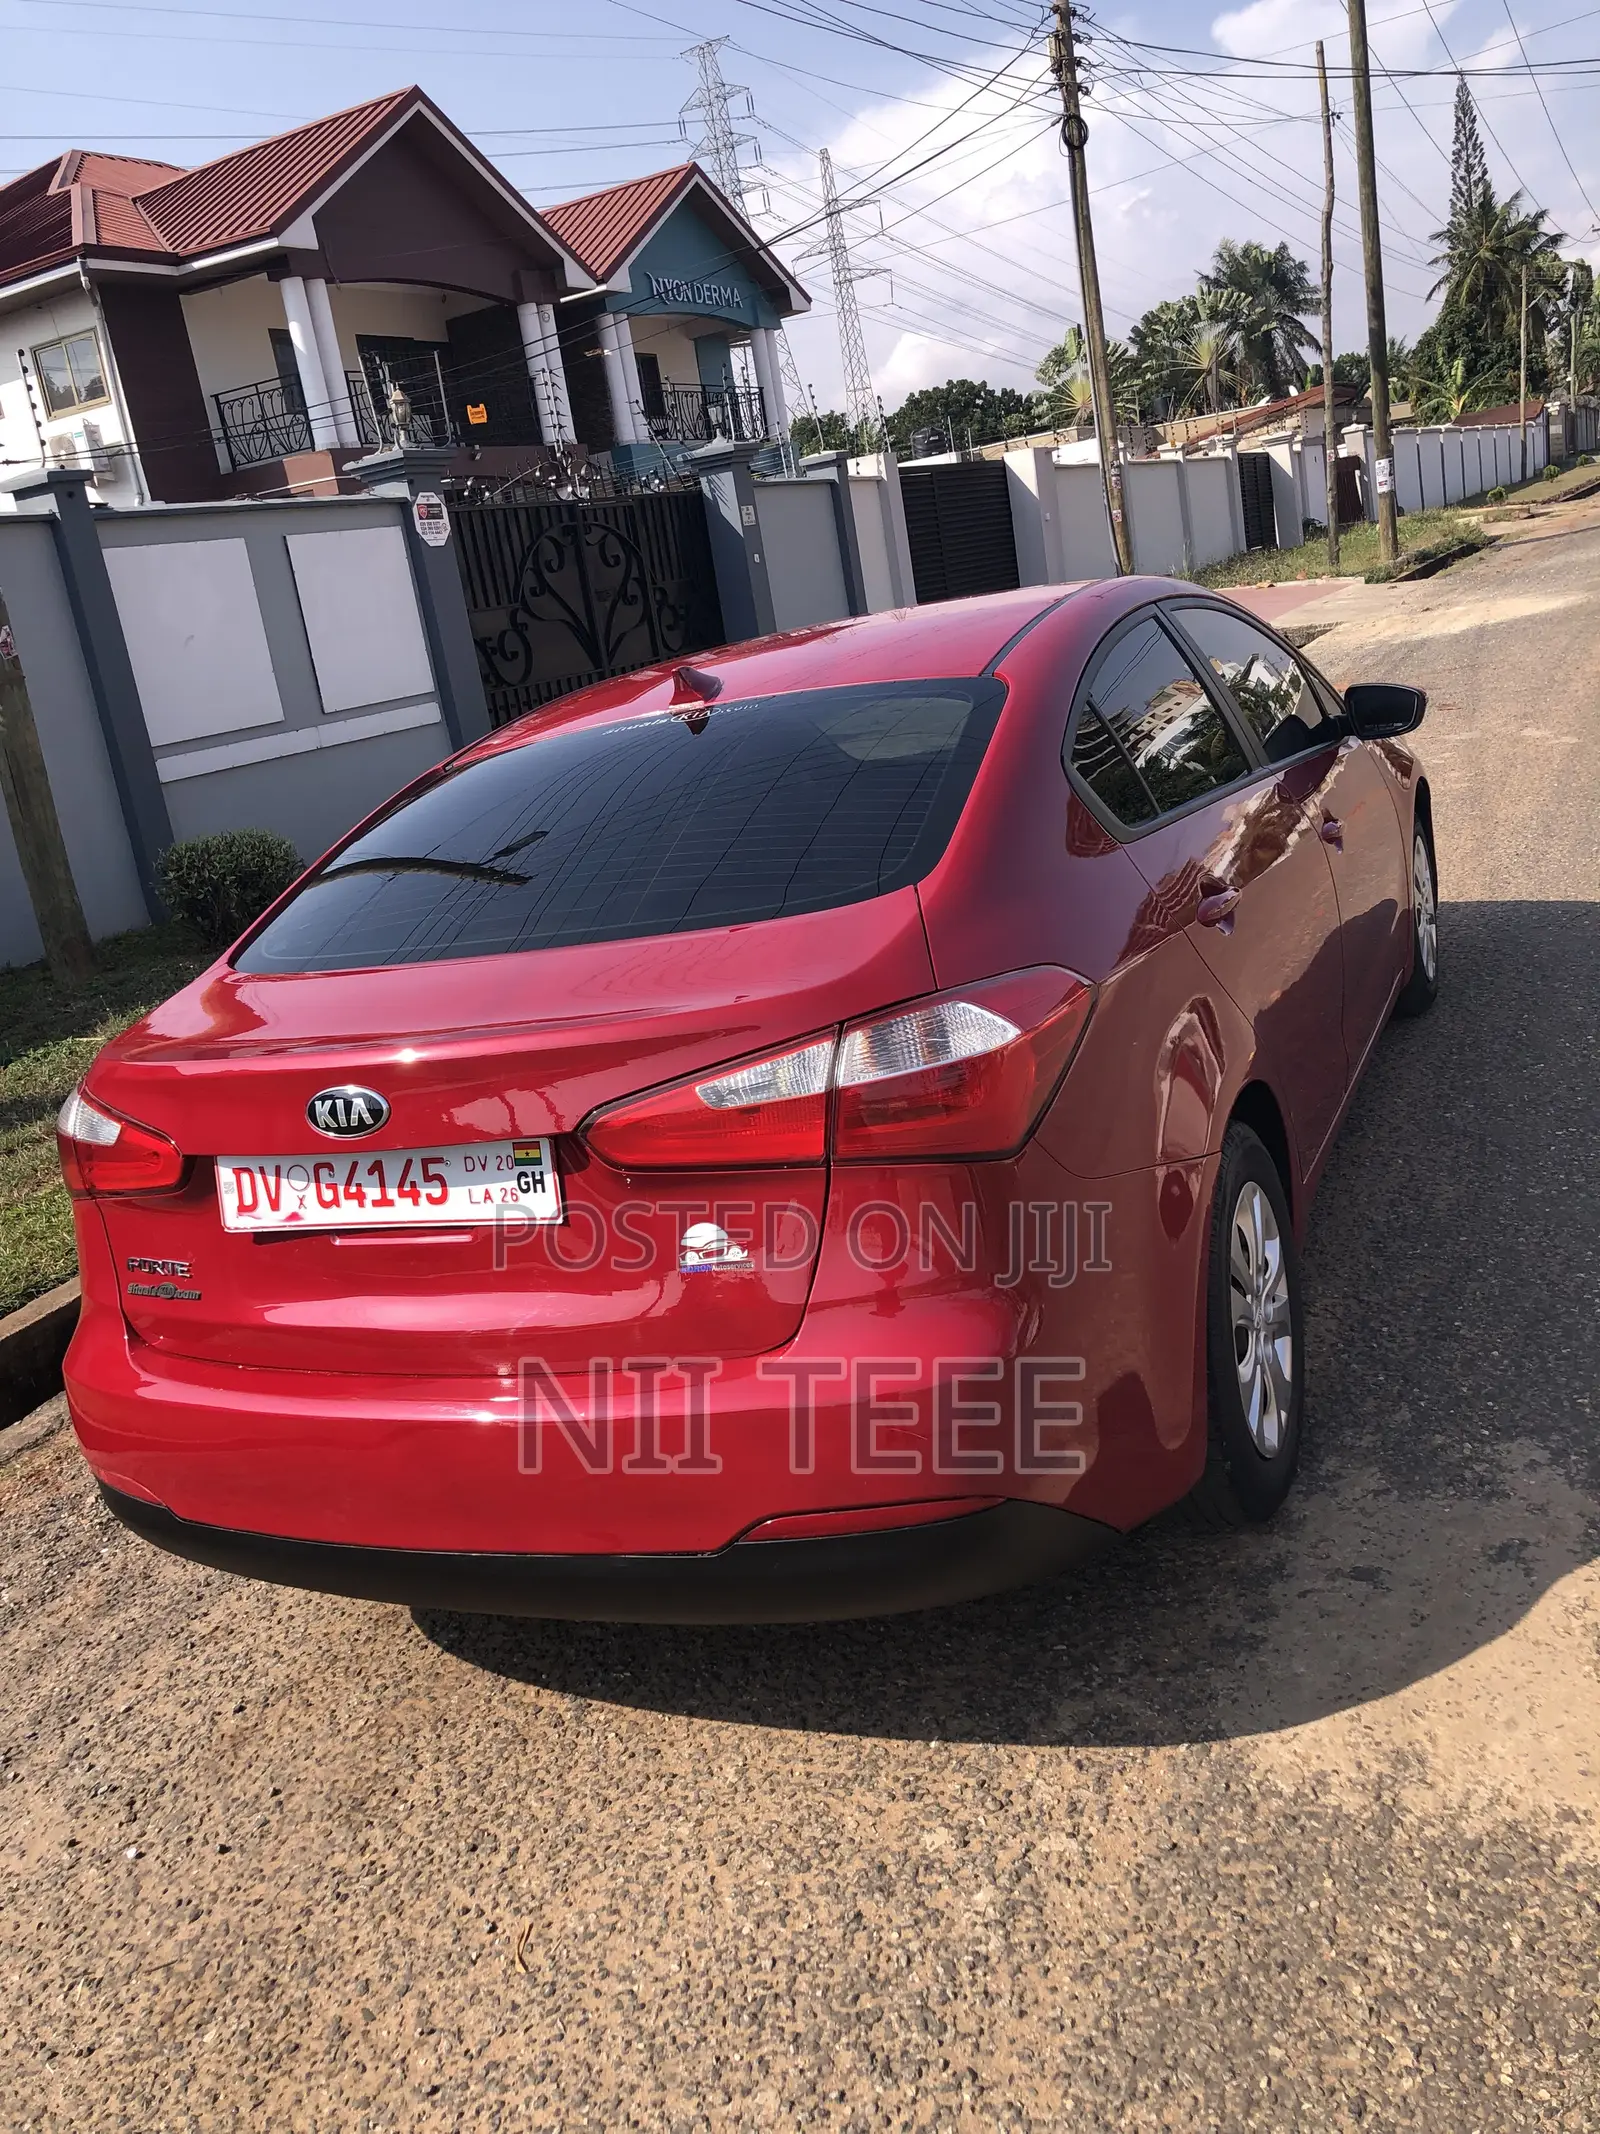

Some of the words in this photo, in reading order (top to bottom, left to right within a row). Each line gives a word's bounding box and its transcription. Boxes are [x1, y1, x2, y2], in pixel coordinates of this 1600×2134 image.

[693, 282, 743, 308] DERMA
[314, 1097, 375, 1128] KIA
[464, 1155, 488, 1172] DV
[495, 1154, 515, 1171] 20
[232, 1164, 282, 1214] DV
[313, 1156, 449, 1209] G4145
[516, 1171, 546, 1194] GH
[468, 1187, 494, 1204] LA
[500, 1186, 519, 1203] 26
[127, 1256, 193, 1278] FORTE
